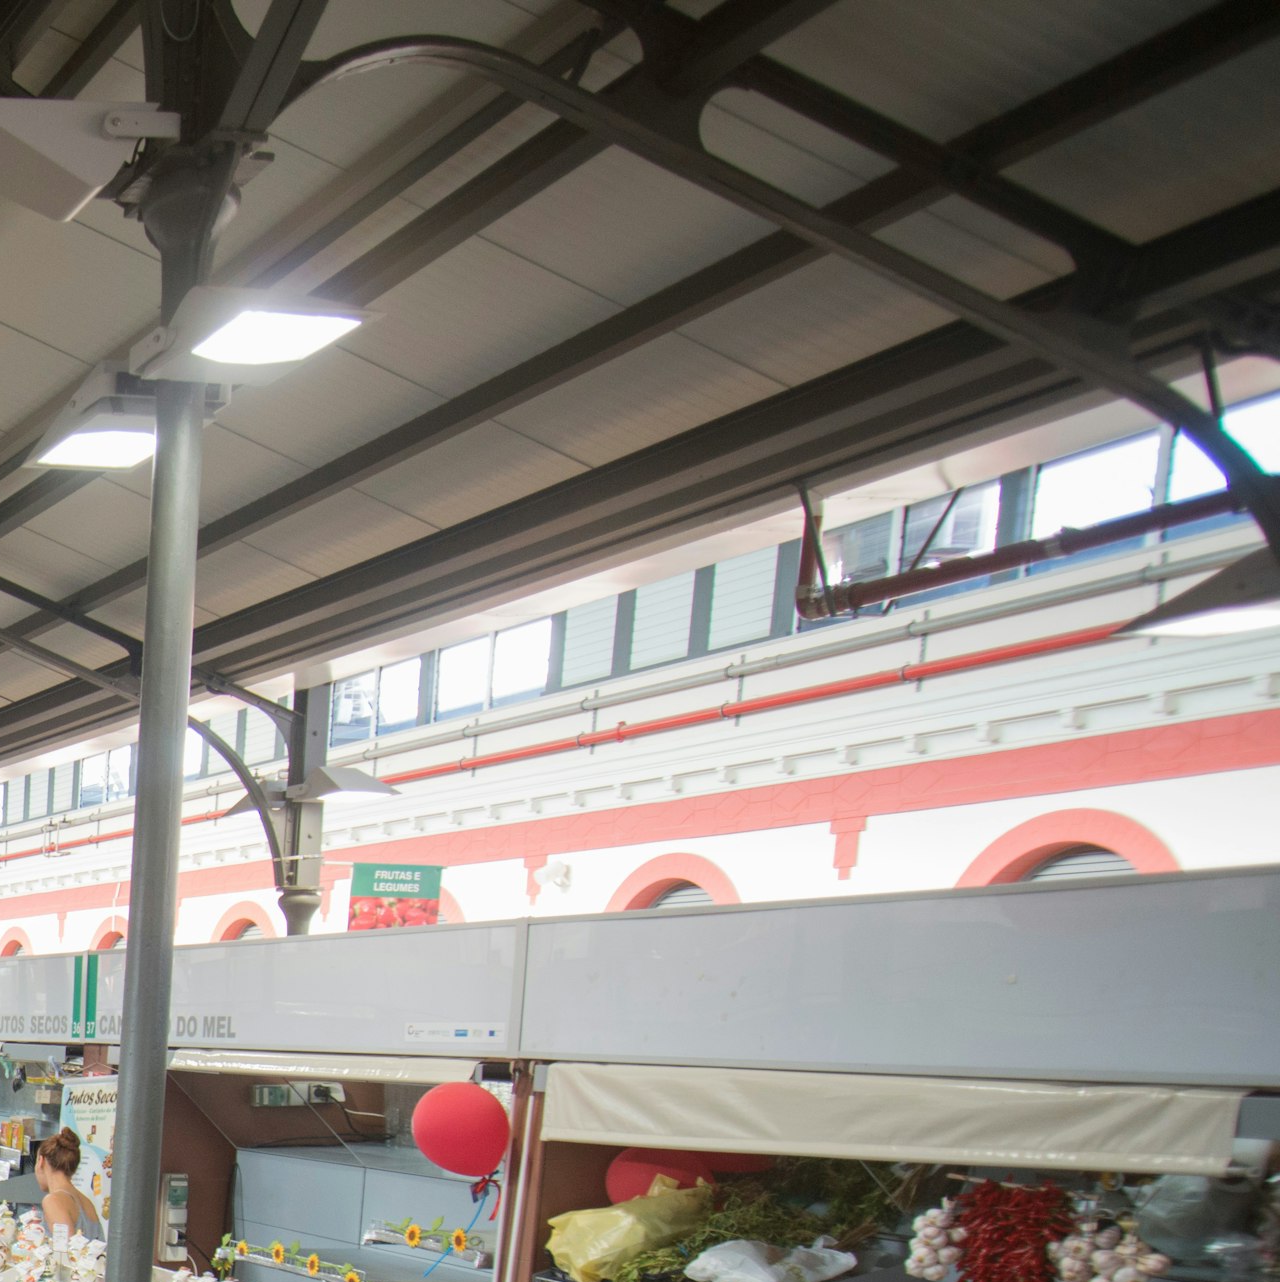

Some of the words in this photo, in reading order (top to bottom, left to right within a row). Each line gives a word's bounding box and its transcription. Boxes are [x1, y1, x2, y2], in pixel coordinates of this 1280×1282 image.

[374, 870, 413, 880] FRUTAS
[414, 871, 421, 880] E
[373, 882, 420, 893] LEGUMES
[30, 1015, 68, 1034] SECOS
[86, 1021, 95, 1035] 37
[176, 1016, 197, 1037] DO
[202, 1016, 236, 1038] MEL
[65, 1090, 95, 1106] Frutos
